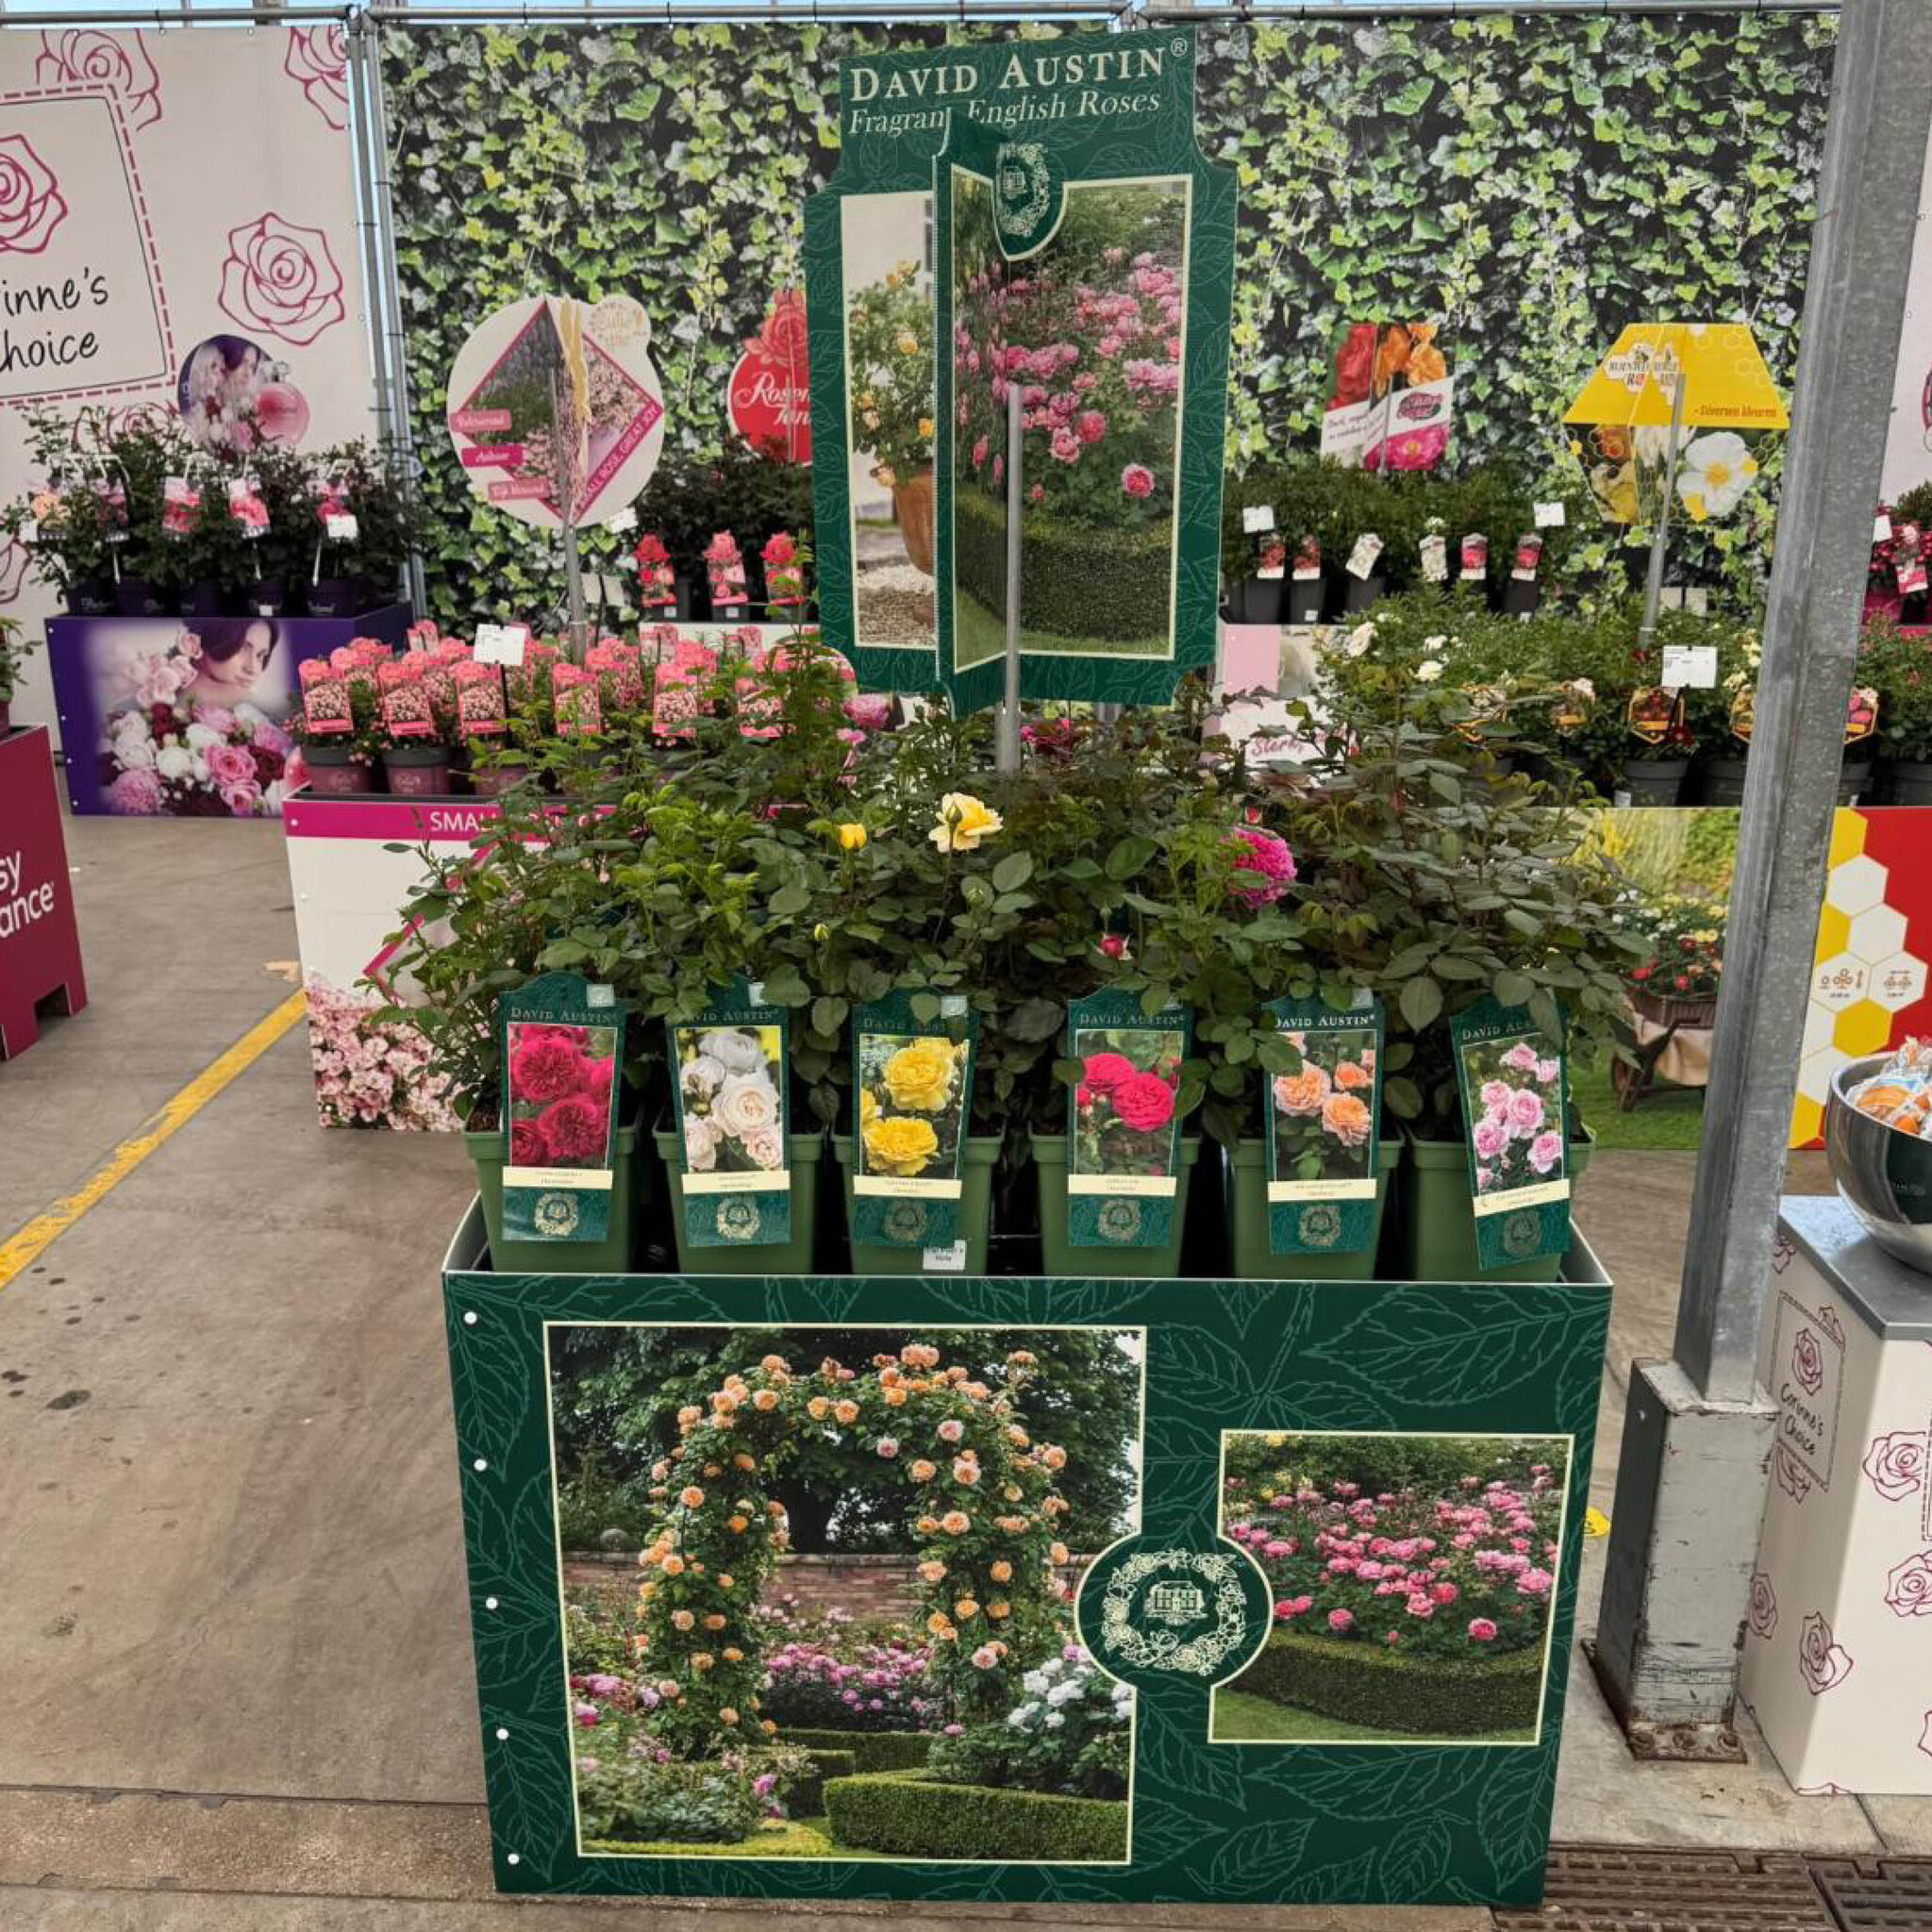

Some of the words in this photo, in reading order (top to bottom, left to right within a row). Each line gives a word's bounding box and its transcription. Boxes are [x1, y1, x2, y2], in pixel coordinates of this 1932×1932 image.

[849, 65, 978, 102] DAVID
[849, 108, 944, 137] Fragran
[968, 92, 1066, 128] English
[1077, 91, 1160, 117] Roses
[0, 266, 108, 317] inne's
[0, 328, 99, 373] hoice
